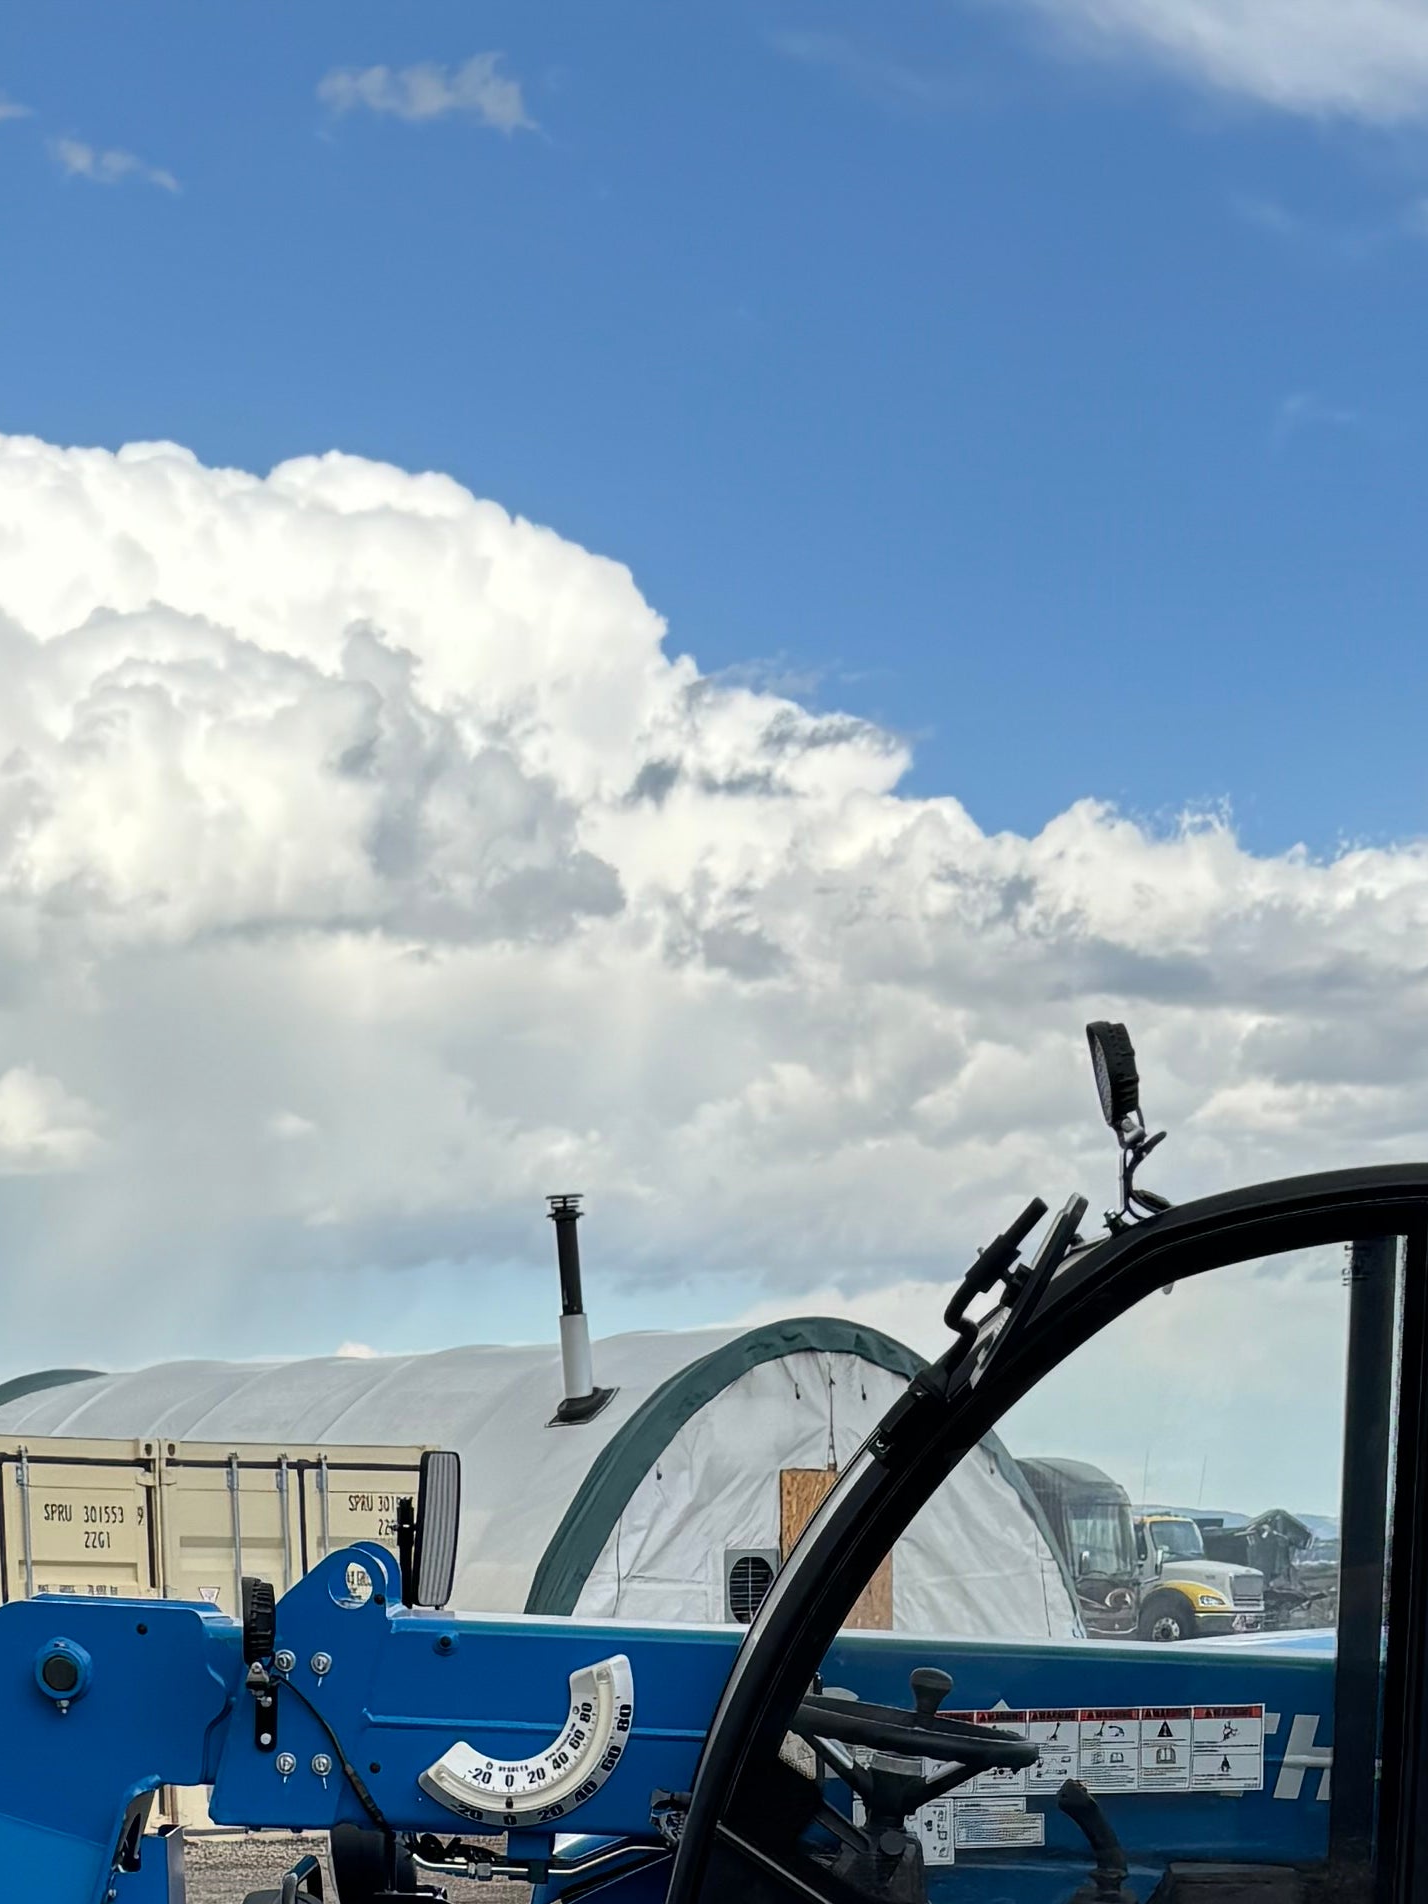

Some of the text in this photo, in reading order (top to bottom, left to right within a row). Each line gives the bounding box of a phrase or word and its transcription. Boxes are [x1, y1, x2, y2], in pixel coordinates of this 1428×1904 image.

[348, 1494, 374, 1512] SPRU
[43, 1503, 145, 1526] SPRU 301553 9
[83, 1531, 112, 1549] 22G1
[579, 1702, 593, 1724] 80
[616, 1703, 632, 1732] 80
[568, 1728, 585, 1750] 60
[552, 1751, 570, 1771] 40
[601, 1745, 622, 1772] 60
[505, 1774, 514, 1788] 0
[527, 1767, 546, 1784] 20
[504, 1814, 517, 1826] 0
[537, 1804, 565, 1822] 20
